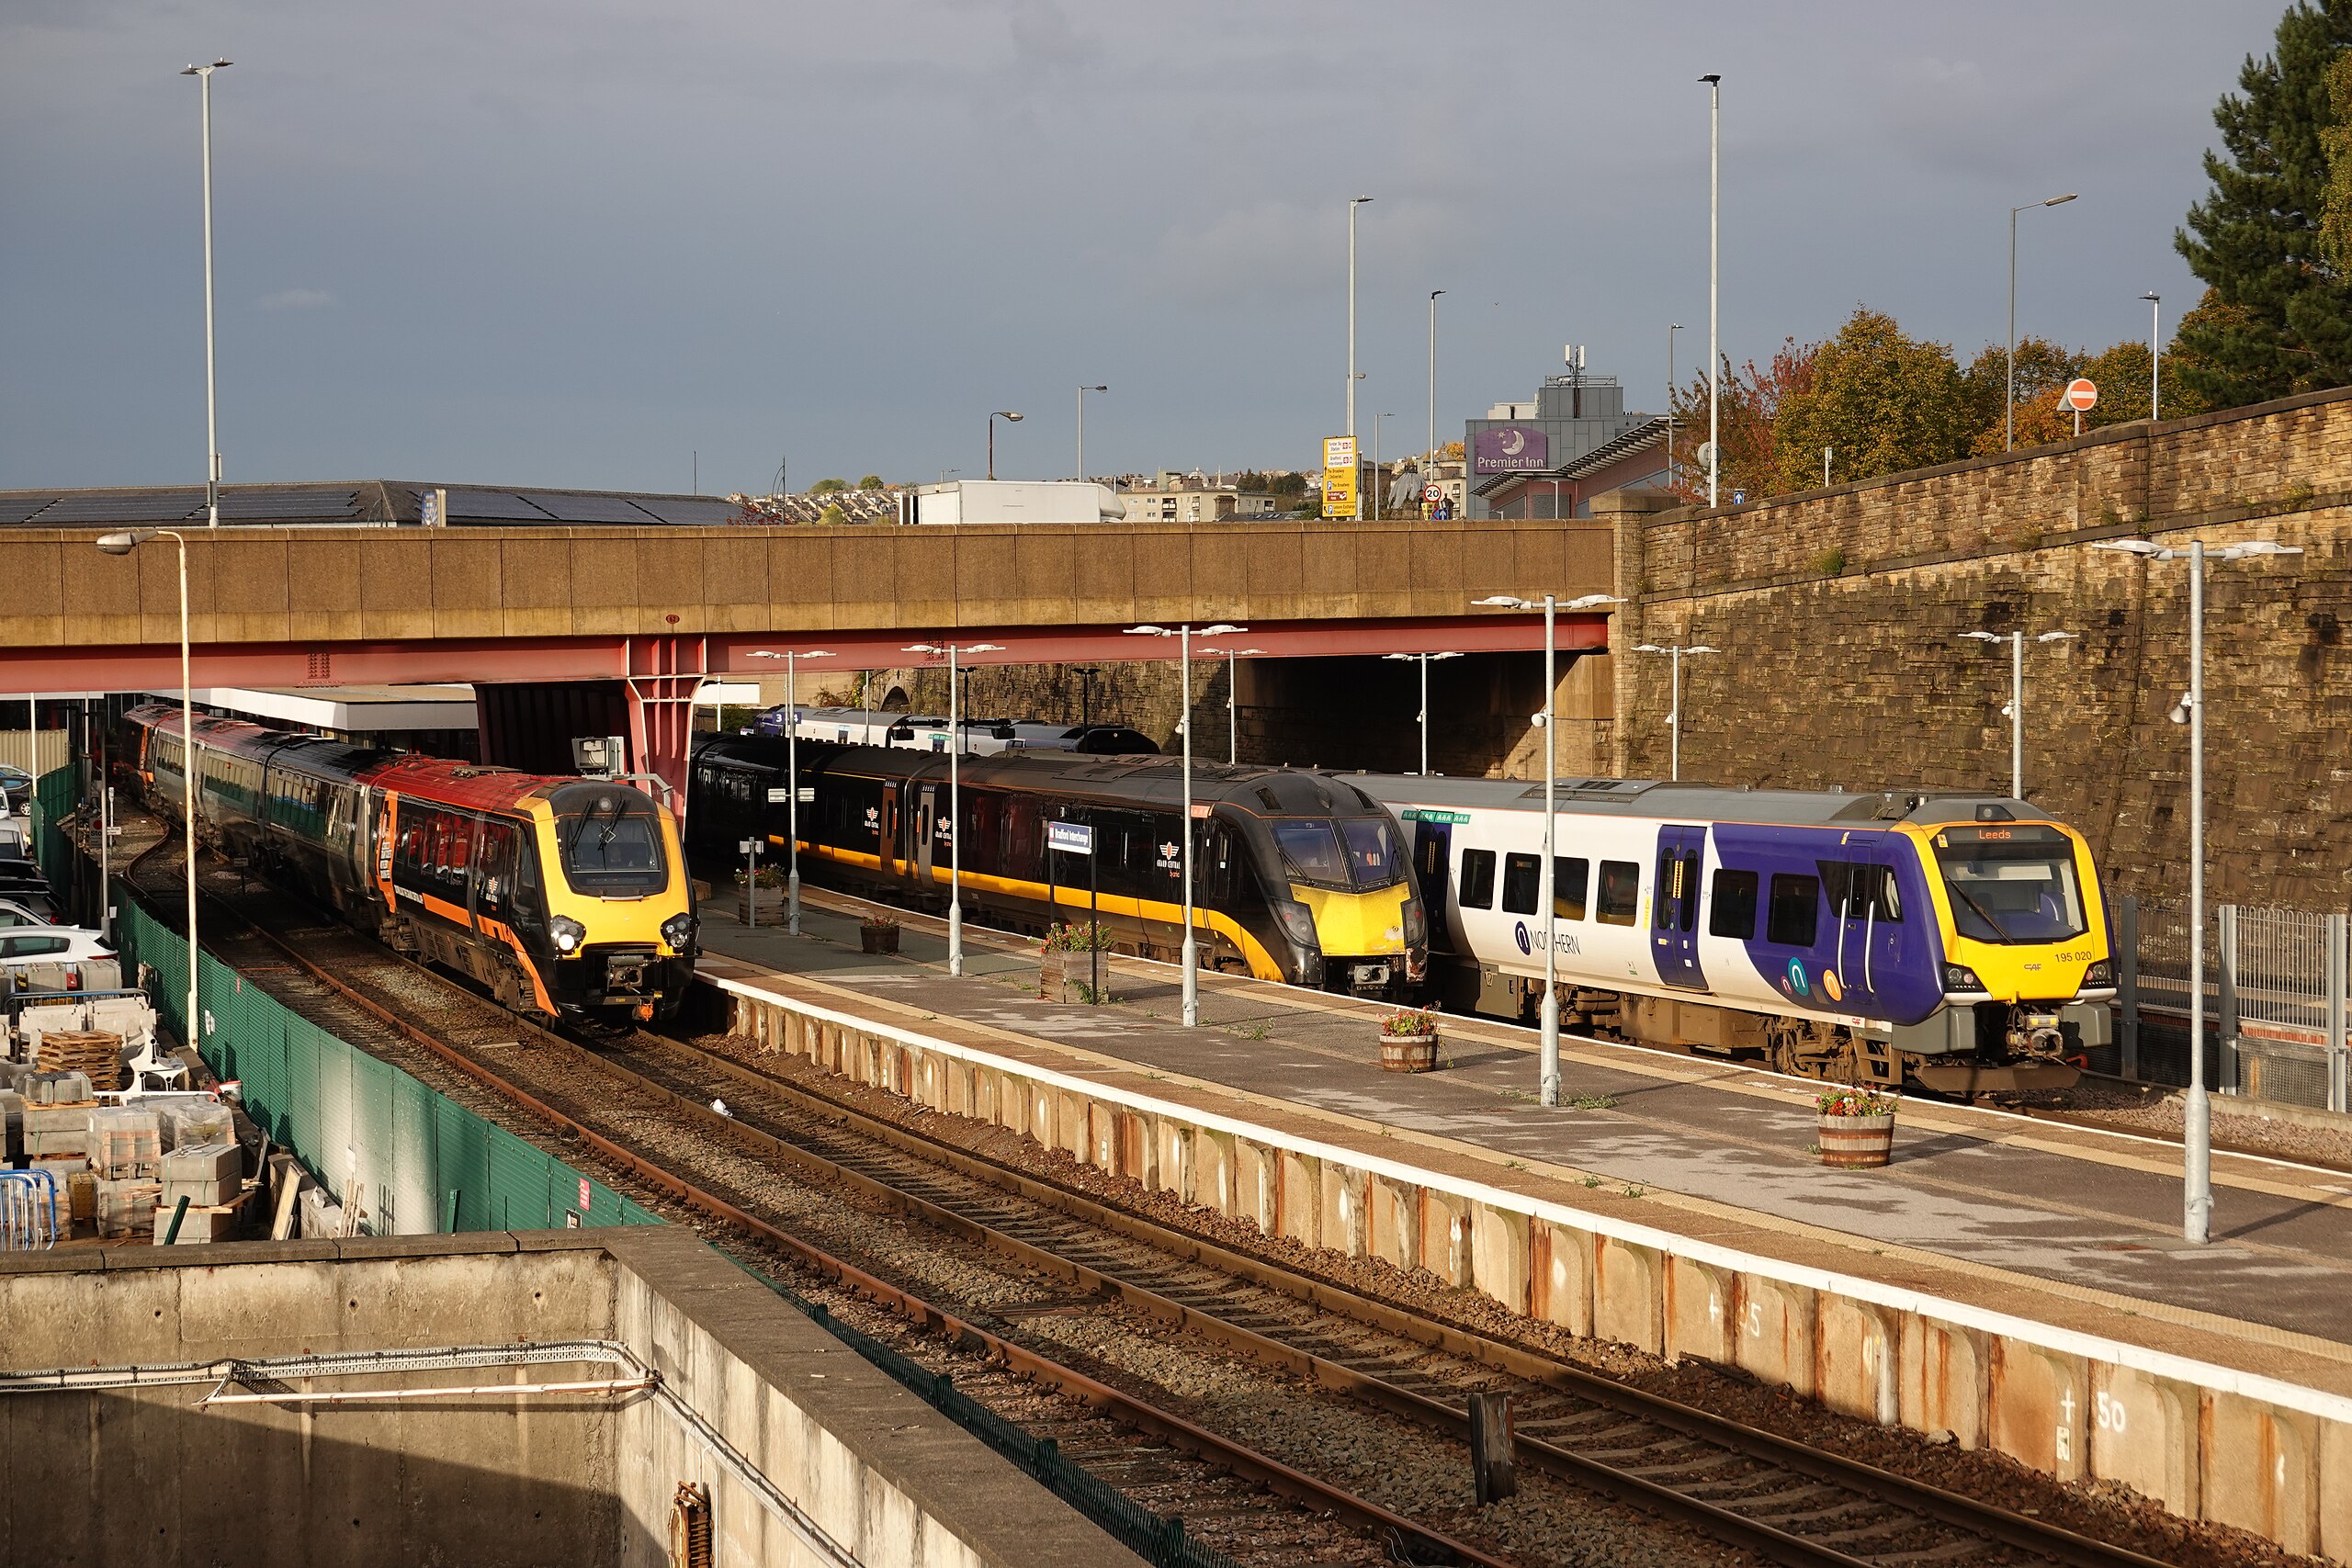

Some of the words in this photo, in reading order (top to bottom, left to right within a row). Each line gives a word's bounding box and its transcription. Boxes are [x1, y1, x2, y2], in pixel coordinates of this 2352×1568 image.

[1477, 457, 1524, 468] Premier
[1526, 457, 1544, 468] Inn
[775, 714, 782, 722] 3
[1978, 829, 2011, 840] Leeds
[1530, 930, 1581, 955] NOHERN
[2054, 953, 2073, 963] 195
[2075, 951, 2092, 961] 020
[2097, 1391, 2126, 1433] 50
